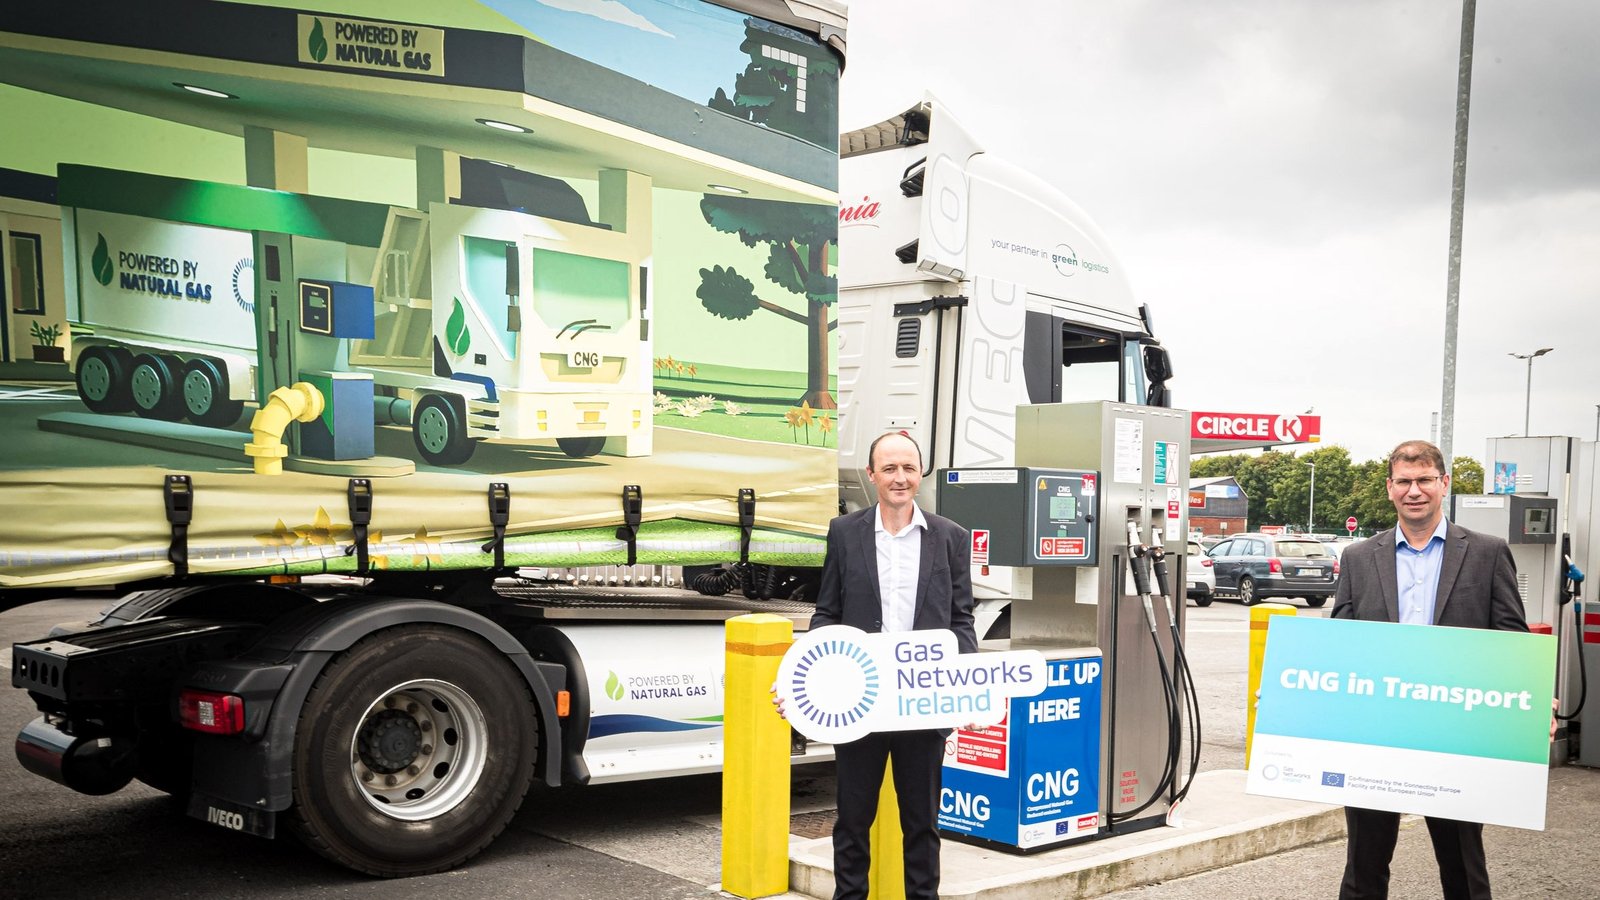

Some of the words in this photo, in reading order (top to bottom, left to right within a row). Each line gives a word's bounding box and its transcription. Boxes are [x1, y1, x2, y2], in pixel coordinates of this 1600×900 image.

[335, 22, 398, 46] POWERED
[402, 29, 418, 48] BY
[335, 44, 401, 67] NATURAL
[403, 51, 432, 71] GAS
[840, 195, 880, 222] nia
[119, 251, 179, 275] POWERED
[183, 260, 198, 280] BY
[991, 239, 1009, 249] your
[1011, 243, 1039, 257] partner
[1041, 249, 1048, 259] in
[1051, 253, 1078, 266] green
[1081, 259, 1109, 274] logistics
[120, 272, 183, 297] NATURAL
[185, 281, 212, 301] GAS
[574, 351, 599, 367] CNG
[1196, 416, 1269, 437] CIRCLE
[1057, 485, 1071, 493] CNG
[1083, 478, 1095, 490] 16
[1189, 495, 1202, 504] iles
[895, 641, 944, 663] Gas
[629, 675, 680, 687] POWERED
[683, 674, 695, 685] BY
[897, 661, 1033, 690] Networks
[1047, 664, 1071, 687] LL
[1074, 662, 1100, 685] UP
[631, 687, 683, 700] NATURAL
[686, 685, 707, 697] GAS
[898, 688, 991, 716] Ireland
[1279, 668, 1339, 693] CNG
[1347, 672, 1375, 696] in
[1382, 676, 1532, 711] Transport
[1028, 697, 1081, 724] HERE
[1026, 767, 1080, 803] CNG
[1347, 782, 1368, 790] Facility
[1387, 786, 1416, 795] European
[1384, 779, 1391, 787] by
[1404, 782, 1438, 792] Connecting
[1439, 786, 1461, 794] Europe
[939, 787, 991, 821] CNG
[207, 806, 244, 831] IVECO
